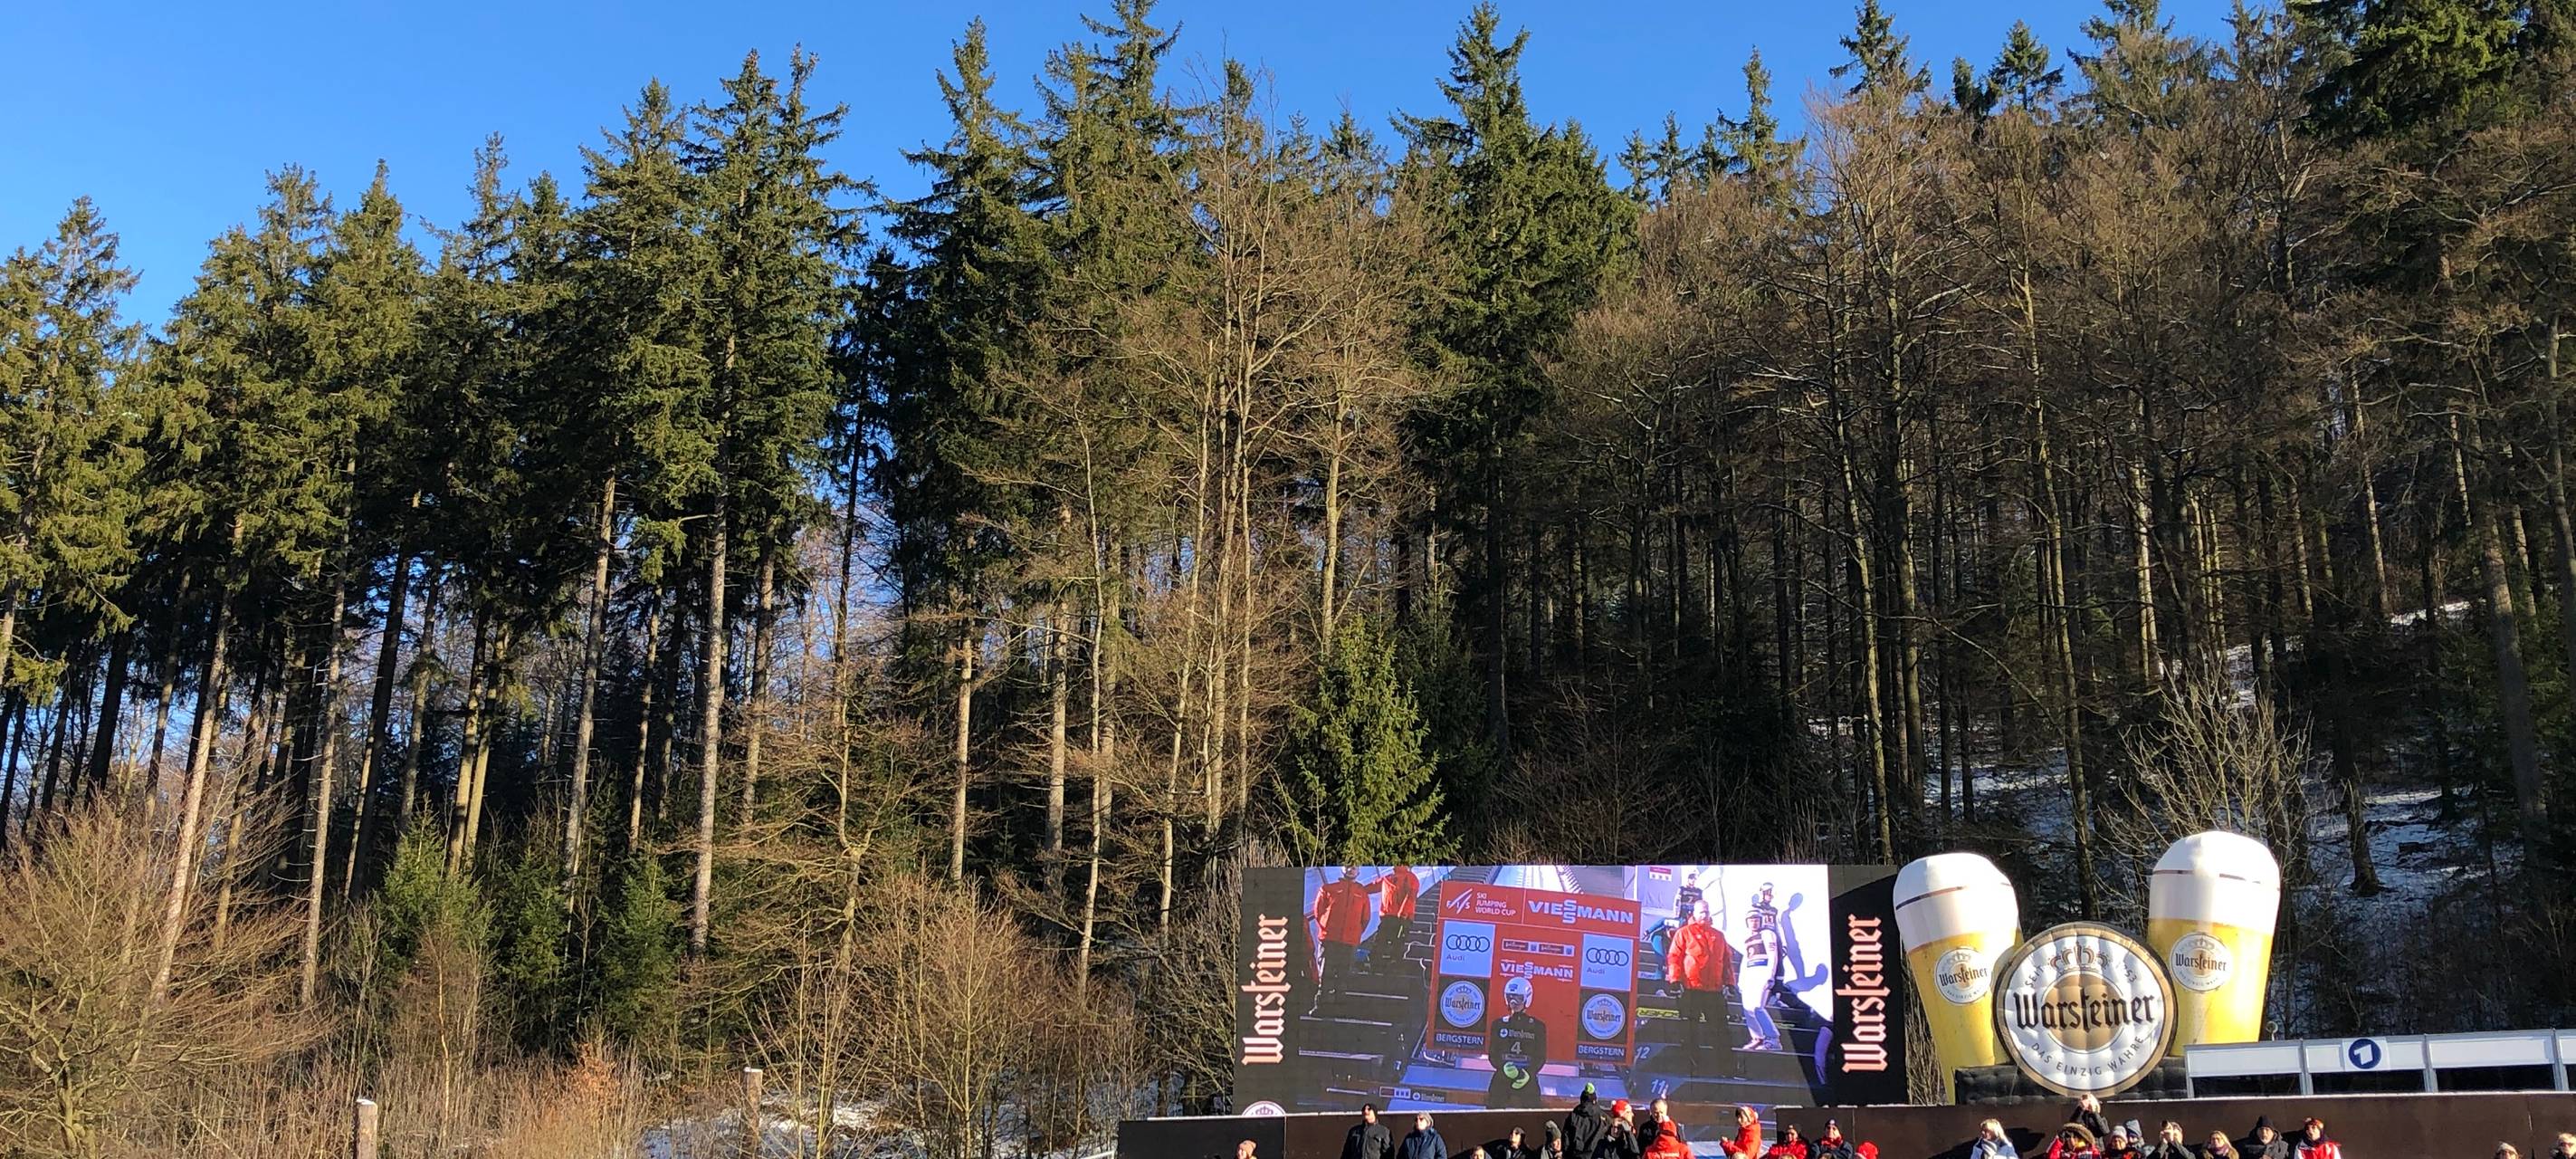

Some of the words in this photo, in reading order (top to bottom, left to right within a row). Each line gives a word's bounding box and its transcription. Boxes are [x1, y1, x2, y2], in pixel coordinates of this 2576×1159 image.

[1475, 906, 1501, 915] WORLD
[1476, 899, 1507, 908] JUMPING
[1528, 899, 1634, 924] VIESSMANN
[1500, 961, 1573, 979] VIESSMANN
[1586, 967, 1606, 975] Audi
[2175, 952, 2228, 972] Warsteiner
[1939, 966, 1988, 987] Warsteiner
[2025, 965, 2045, 988] SEIT
[1241, 914, 1292, 1066] Warsteiner
[1835, 914, 1891, 1073] Warsteiner
[2013, 988, 2155, 1033] Warsteiner
[1436, 1033, 1484, 1045] BERGSTERN
[1511, 1041, 1522, 1054] 4
[1578, 1045, 1625, 1056] BERGSTERN
[1636, 1047, 1650, 1058] 12
[2031, 1043, 2053, 1064] DAS
[2056, 1064, 2102, 1077] EINZIG
[2107, 1036, 2144, 1071] WAHRE
